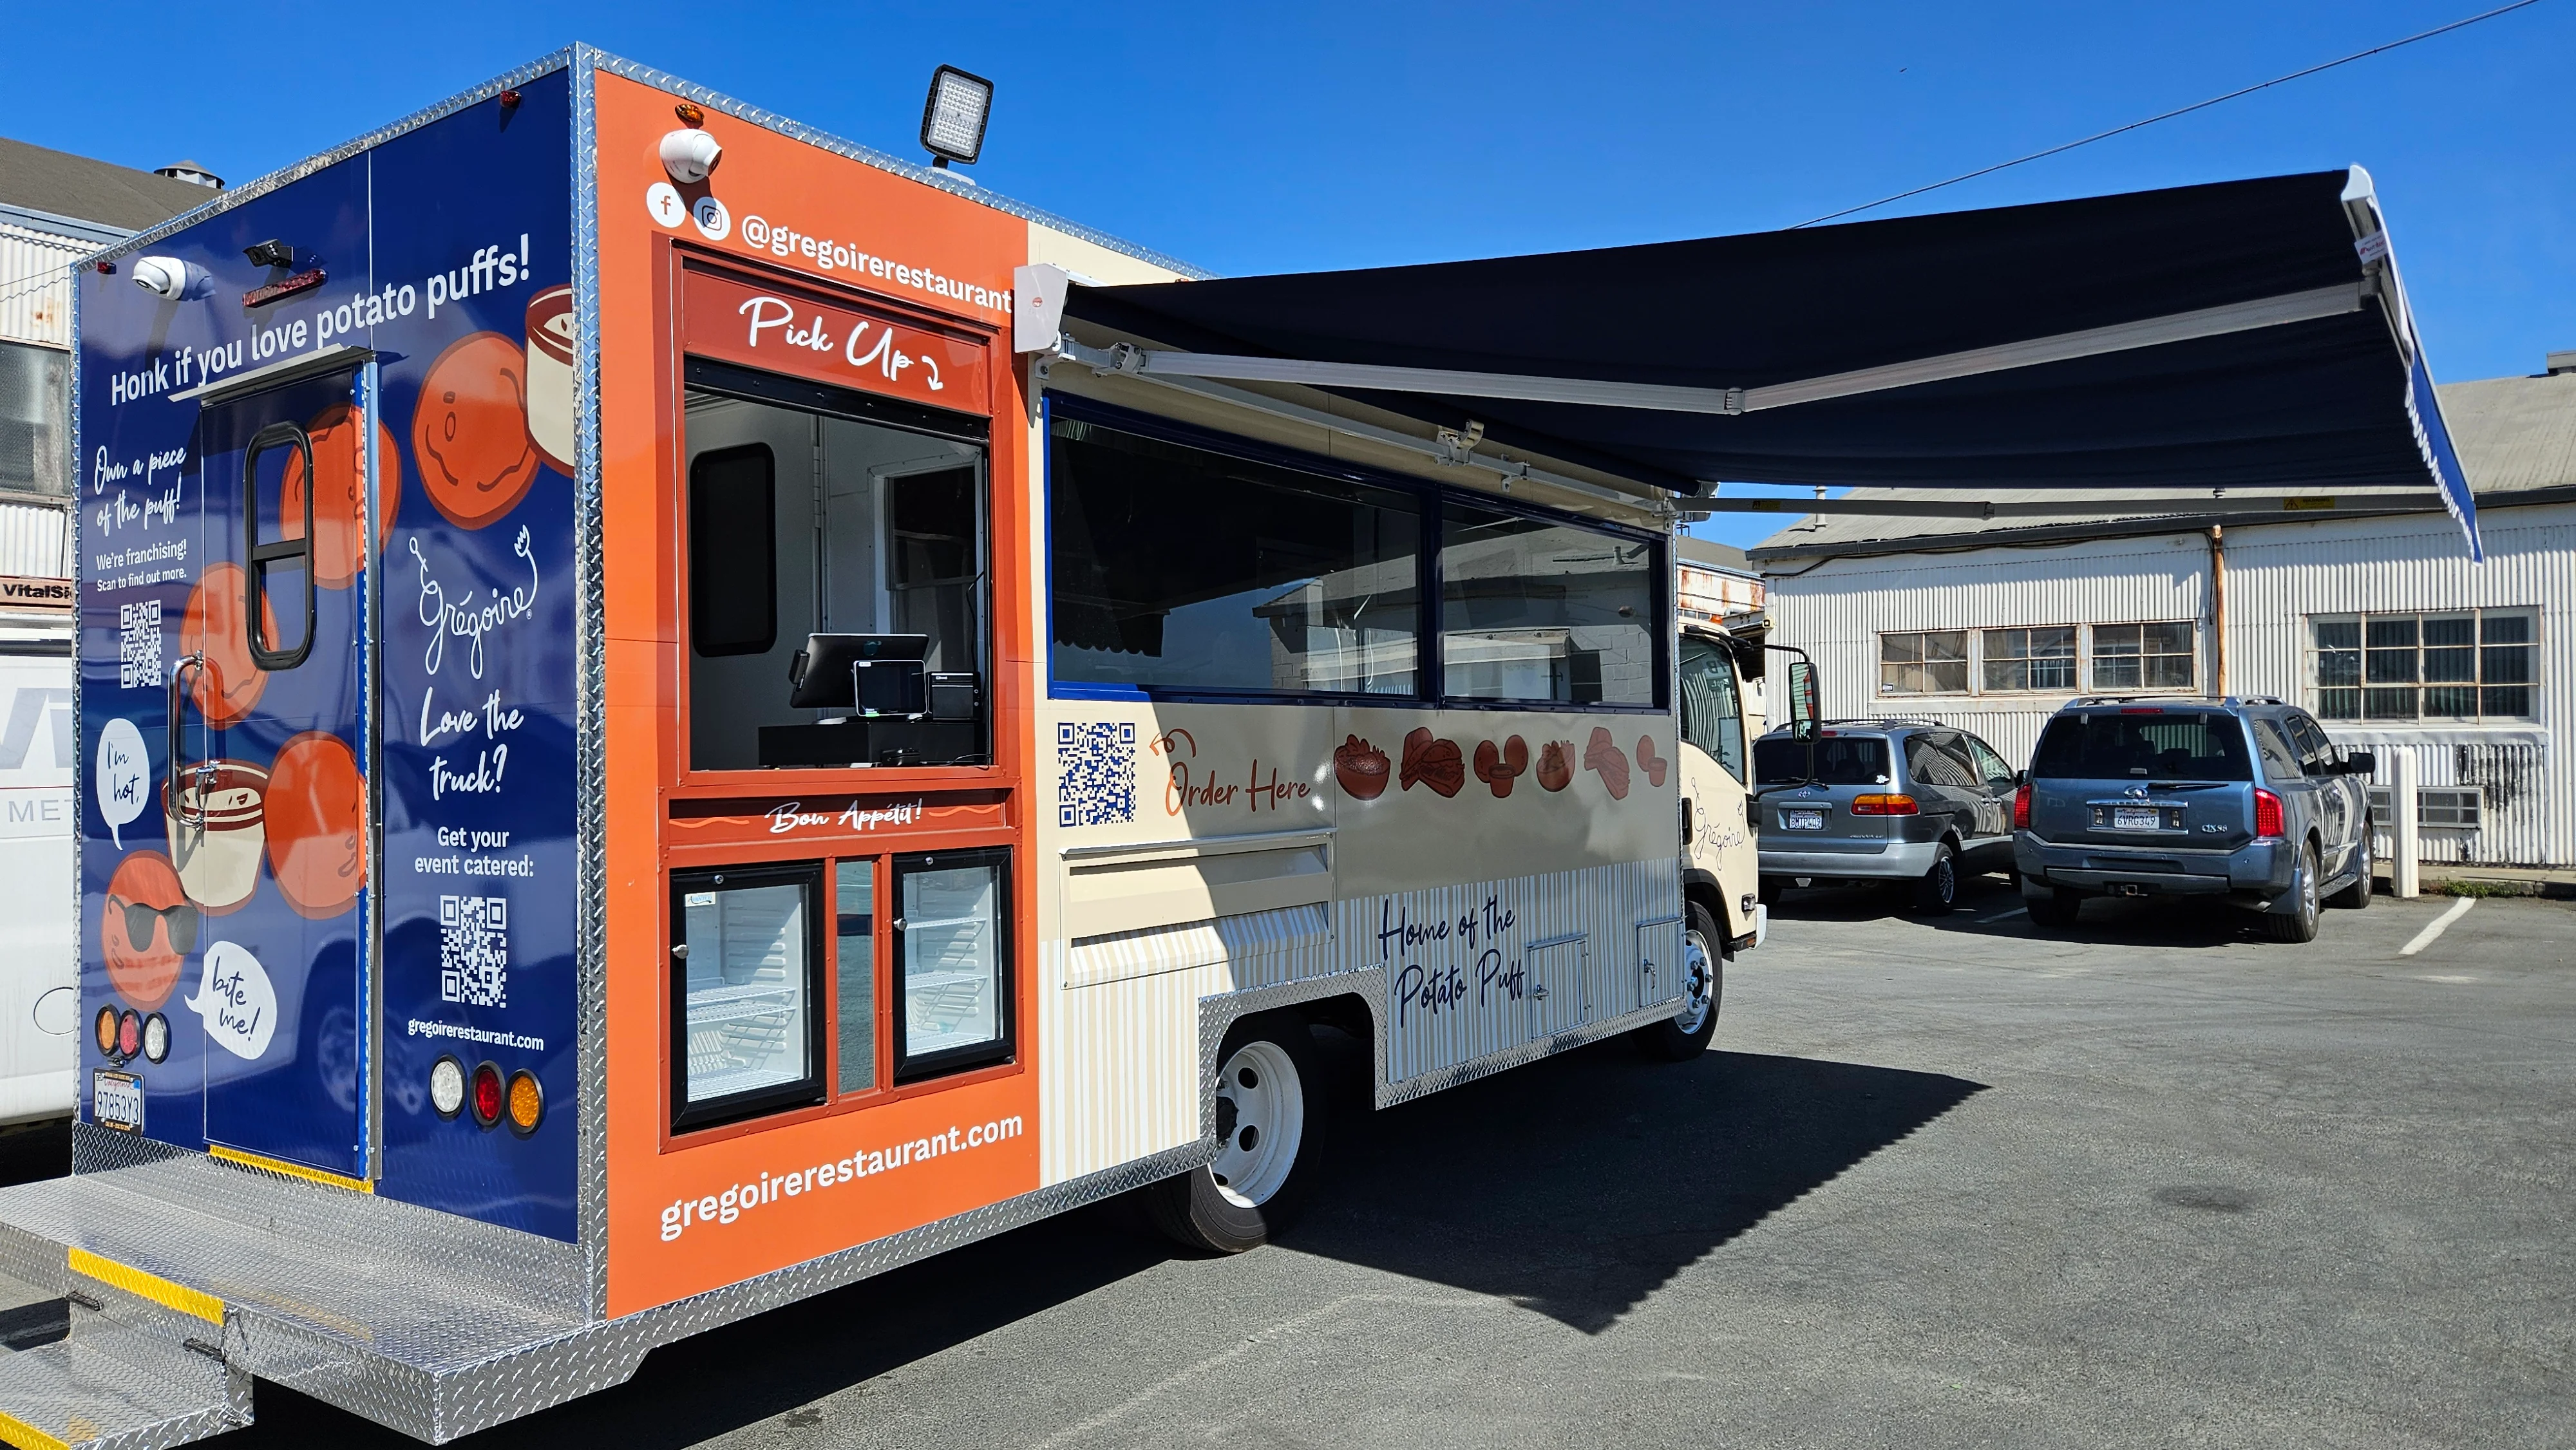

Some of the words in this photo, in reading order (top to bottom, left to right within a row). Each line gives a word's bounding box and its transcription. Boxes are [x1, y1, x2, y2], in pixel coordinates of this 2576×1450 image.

[741, 214, 1012, 314] @gregoirerestaurant
[112, 359, 169, 406] Honk
[175, 350, 193, 385] if
[198, 339, 243, 385] you
[252, 314, 308, 361] love
[316, 282, 415, 341] potato
[428, 233, 530, 319] puffs!
[739, 296, 834, 348] Pick
[846, 321, 914, 382] Up
[94, 445, 128, 495] Own
[133, 459, 144, 476] a
[148, 447, 187, 485] piece
[97, 503, 112, 537] of
[114, 489, 140, 529] the
[144, 471, 183, 531] puff!
[96, 552, 124, 571] We're
[126, 538, 187, 567] franchising!
[97, 579, 117, 592] Scan
[117, 576, 127, 589] to
[128, 570, 144, 587] find
[146, 570, 161, 584] out
[162, 567, 187, 583] more.
[3, 583, 72, 599] VitalSi
[409, 525, 538, 680] Grégoire
[420, 686, 478, 747] Love
[482, 688, 525, 740] the
[108, 741, 129, 769] I'm
[428, 743, 507, 801] truck?
[1166, 762, 1238, 816] Order
[1245, 758, 1311, 812] Here
[437, 826, 467, 847] Get
[471, 831, 509, 853] your
[764, 801, 829, 834] Bon
[837, 798, 922, 831] Appétit!
[2117, 815, 2156, 825] 6VRG349
[415, 854, 459, 874] event
[464, 854, 535, 878] catered:
[1378, 898, 1450, 961] Home
[1459, 908, 1478, 950] of
[1482, 894, 1516, 940] the
[213, 956, 247, 1008] bite
[1394, 965, 1467, 1029] Potato
[1475, 948, 1525, 1008] Puff
[220, 1006, 261, 1042] me!
[408, 1018, 545, 1051] gregoirerestaurant.com
[660, 1115, 1023, 1241] gregoirerestaurant.com
